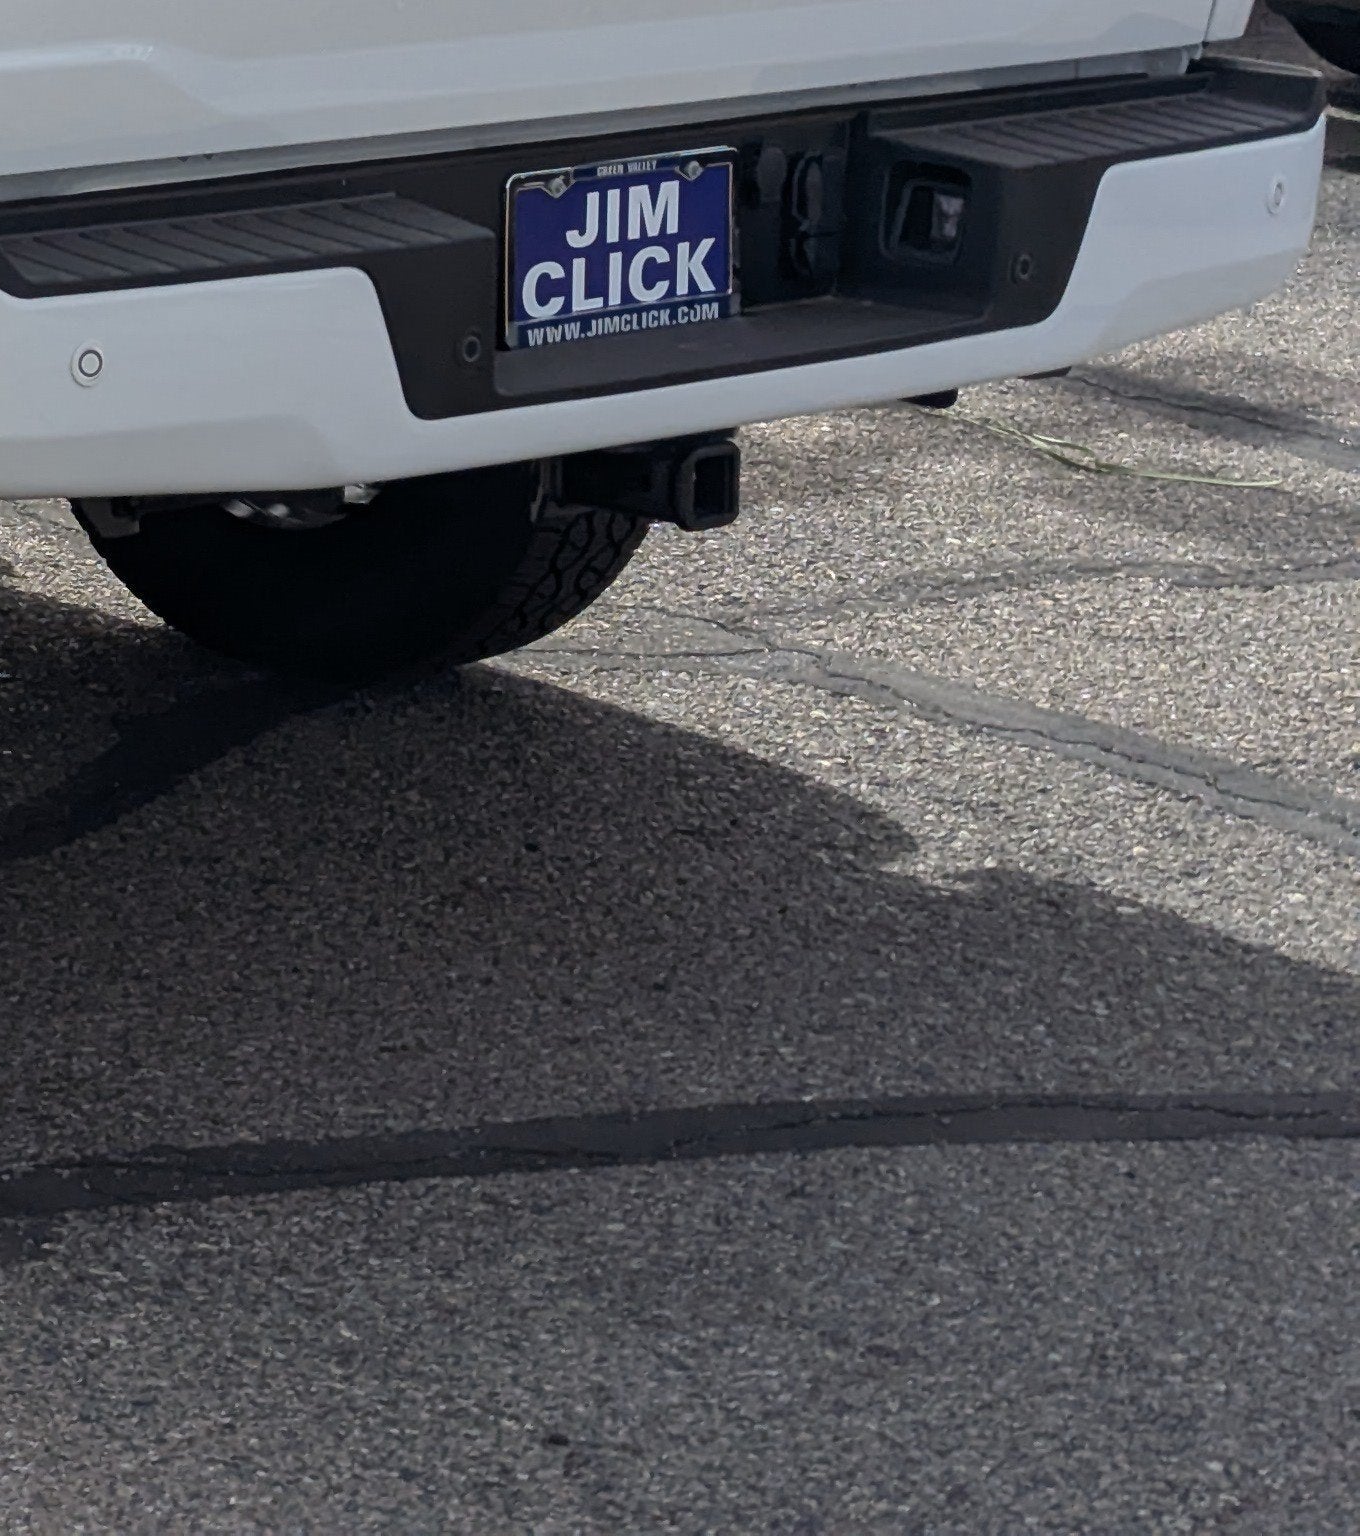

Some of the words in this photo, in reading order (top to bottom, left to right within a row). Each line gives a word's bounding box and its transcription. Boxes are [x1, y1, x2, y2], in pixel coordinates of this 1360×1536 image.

[565, 179, 680, 248] JIM
[521, 237, 716, 320] CLICK
[527, 301, 720, 348] WWW.JIMCLICK.COM
